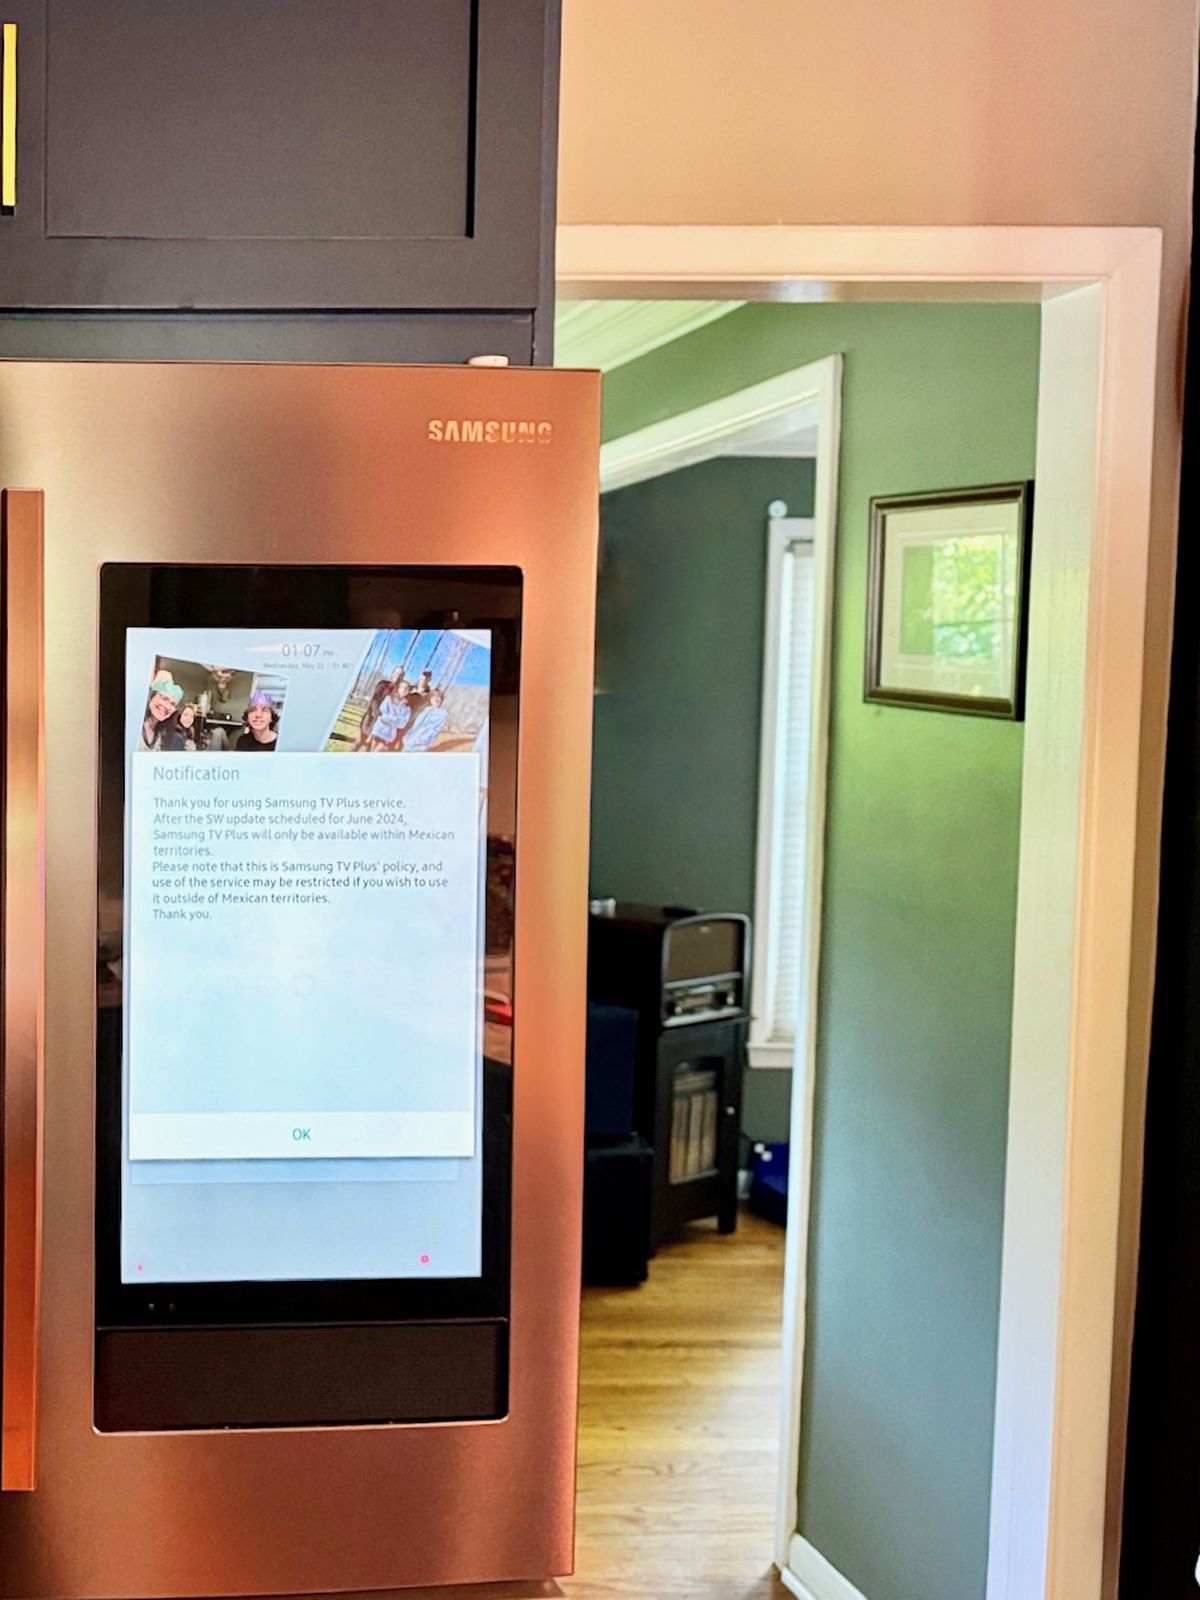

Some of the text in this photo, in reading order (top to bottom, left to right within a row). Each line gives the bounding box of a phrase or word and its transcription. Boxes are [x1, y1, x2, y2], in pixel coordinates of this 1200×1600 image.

[428, 420, 552, 443] SAMSUNG
[153, 766, 240, 781] Notification
[154, 797, 406, 810] Thank you for using Samsung TV Plus service.
[153, 813, 407, 826] After the SW update scheduled for June 2024,
[153, 829, 455, 842] Samsung TV Plus will only be available within Mexican
[153, 845, 214, 856] territories.
[152, 861, 189, 872] Please
[192, 862, 218, 872] note
[220, 861, 243, 872] that
[246, 861, 267, 872] this
[270, 861, 279, 872] is
[282, 861, 333, 874] Samsung
[336, 861, 351, 872] TV
[383, 861, 420, 874] policy,
[421, 861, 443, 872] and
[152, 876, 448, 889] use of the service may be restricted if you wish to use
[152, 892, 331, 904] it outside of Mexican territories.
[153, 909, 213, 921] Thank you.
[292, 1128, 311, 1141] OK
